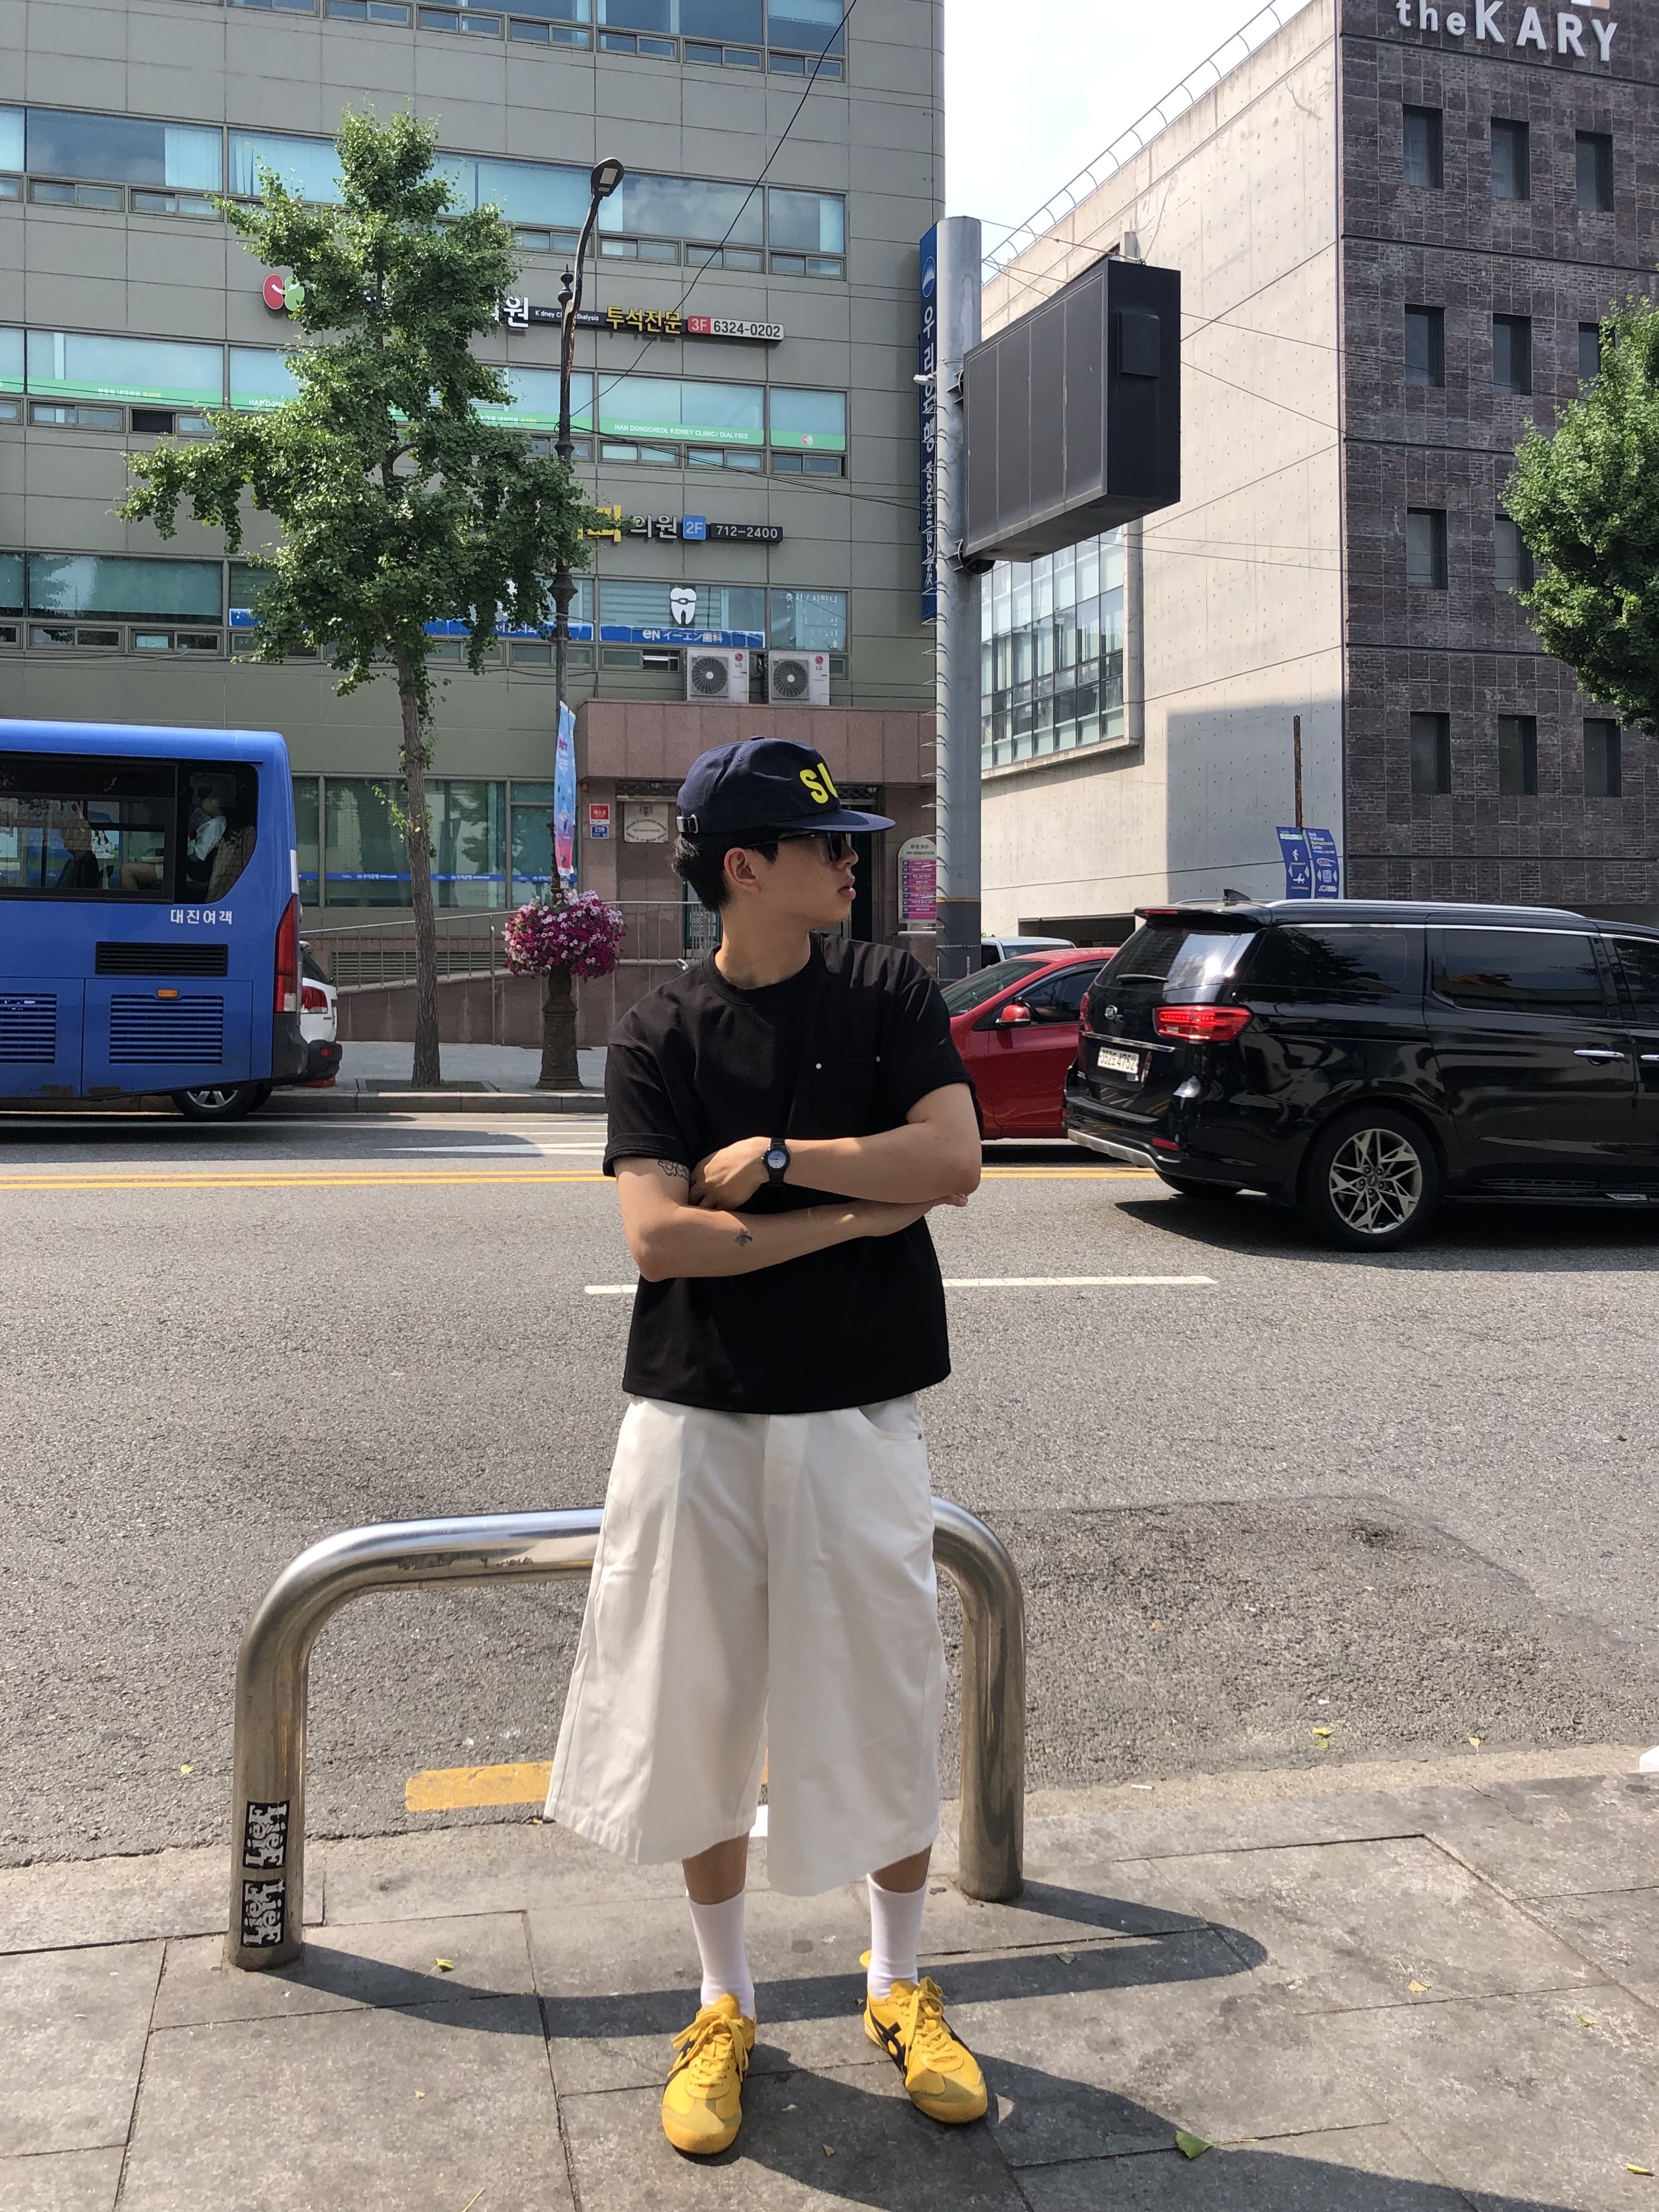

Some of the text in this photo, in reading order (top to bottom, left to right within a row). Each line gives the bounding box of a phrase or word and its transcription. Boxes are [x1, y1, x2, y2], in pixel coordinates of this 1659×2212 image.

[535, 310, 554, 318] Kdney
[606, 306, 682, 335] 투석전문
[691, 317, 780, 338] 3F 6324-0202
[630, 426, 669, 434] DONGCHEOL
[720, 431, 748, 440] DIALYSIS
[630, 514, 677, 539] 의원
[685, 521, 778, 539] 2F 712-2400
[170, 909, 232, 925] 대진여객
